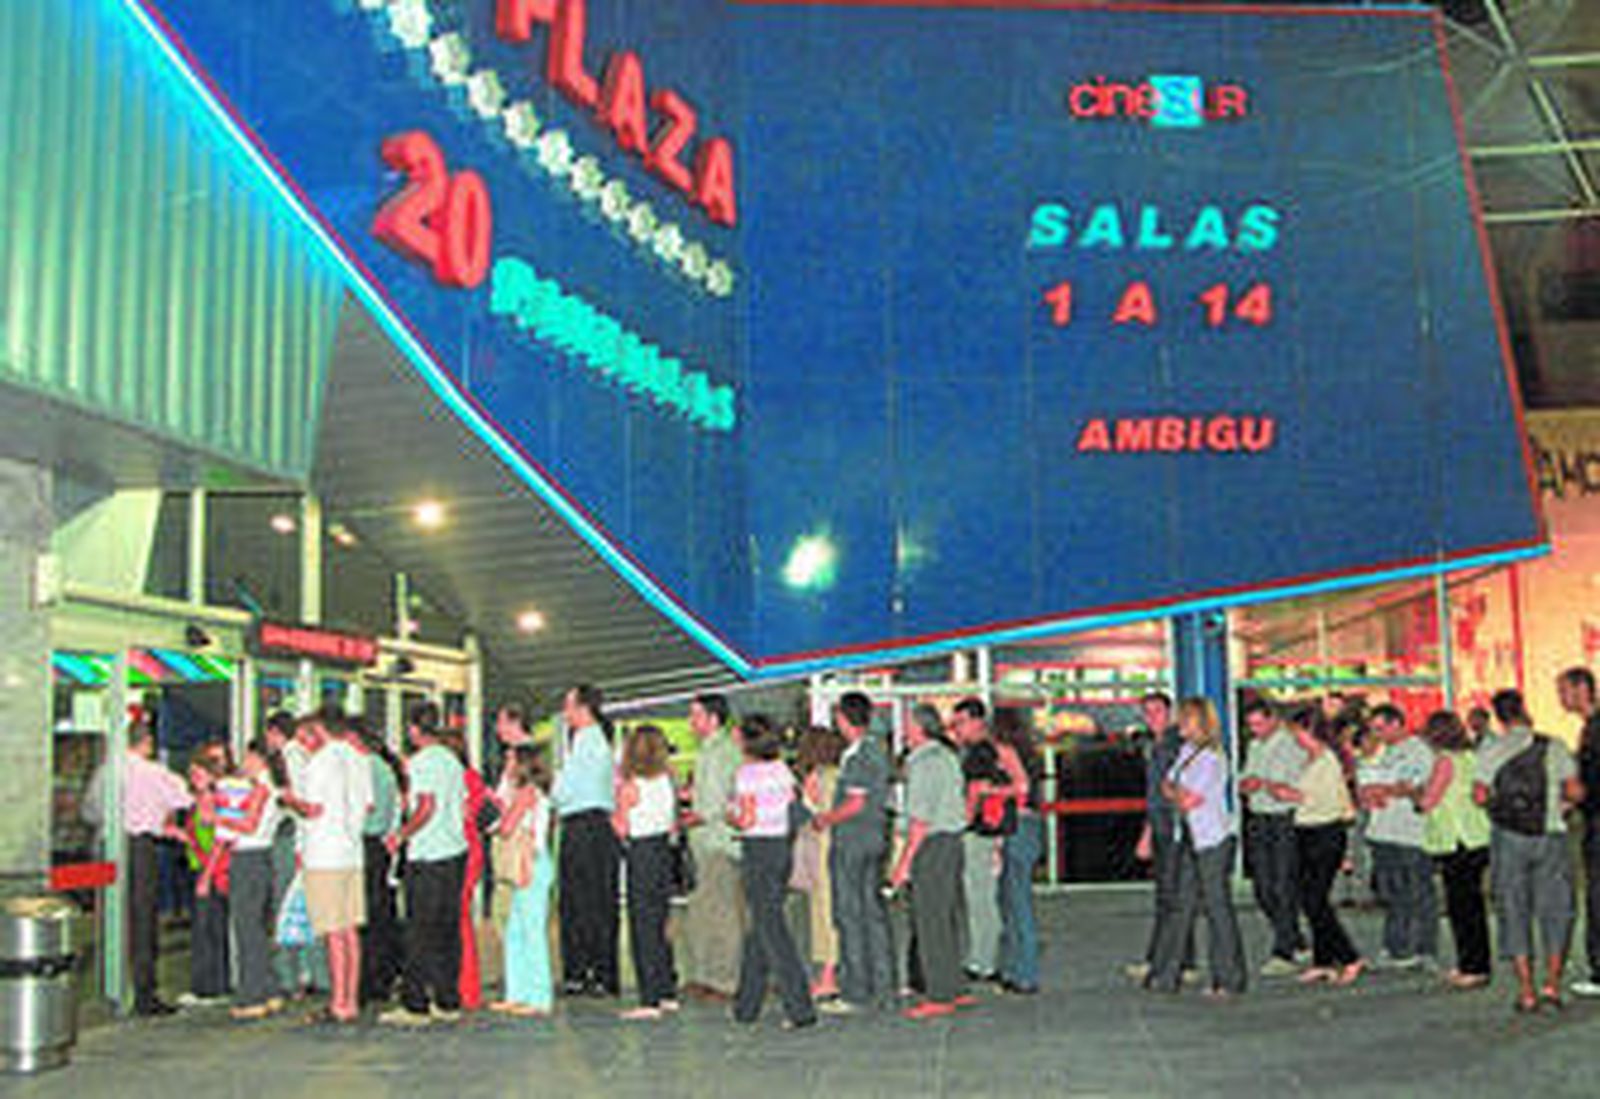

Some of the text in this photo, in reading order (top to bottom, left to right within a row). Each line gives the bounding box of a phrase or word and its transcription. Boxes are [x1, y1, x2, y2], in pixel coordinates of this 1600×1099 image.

[371, 130, 492, 288] 20
[1027, 203, 1280, 250] SALAS
[1044, 281, 1272, 327] 1 A 14
[1077, 416, 1275, 452] AMBIGU
